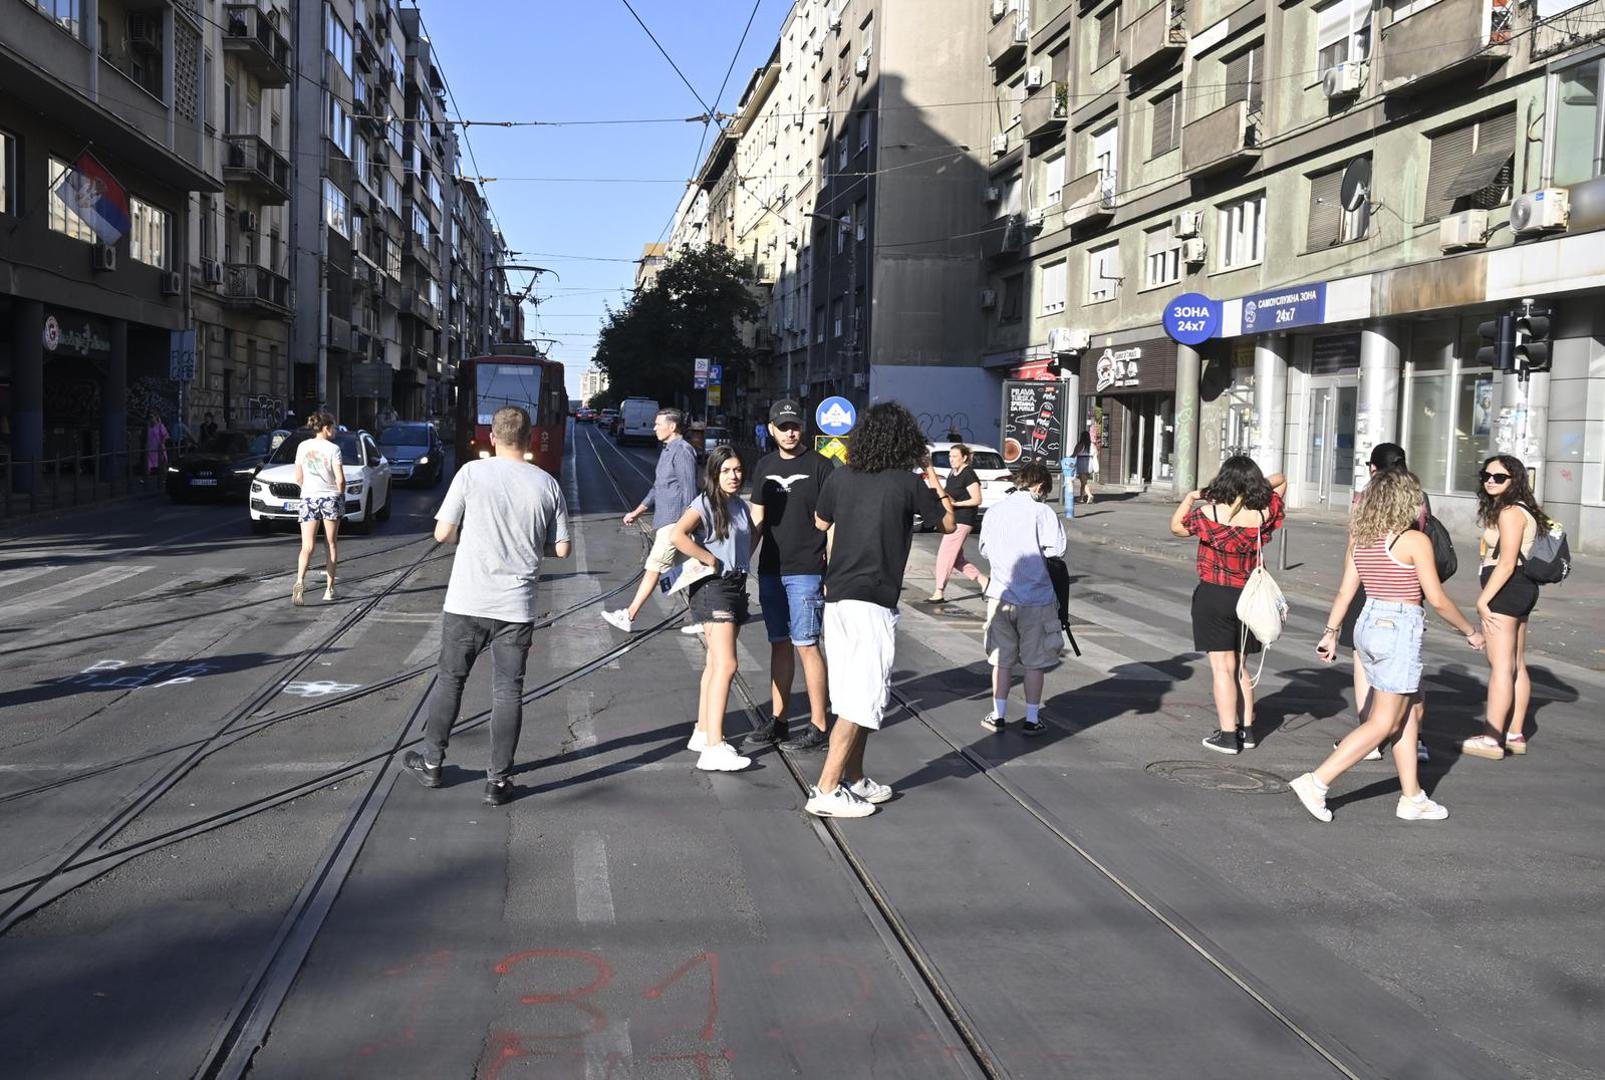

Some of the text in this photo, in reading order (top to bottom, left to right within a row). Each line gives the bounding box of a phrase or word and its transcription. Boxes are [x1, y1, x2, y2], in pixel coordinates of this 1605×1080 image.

[1300, 290, 1317, 302] ЗОНА
[1174, 306, 1210, 318] ЗОНА
[1177, 320, 1206, 331] 24x7
